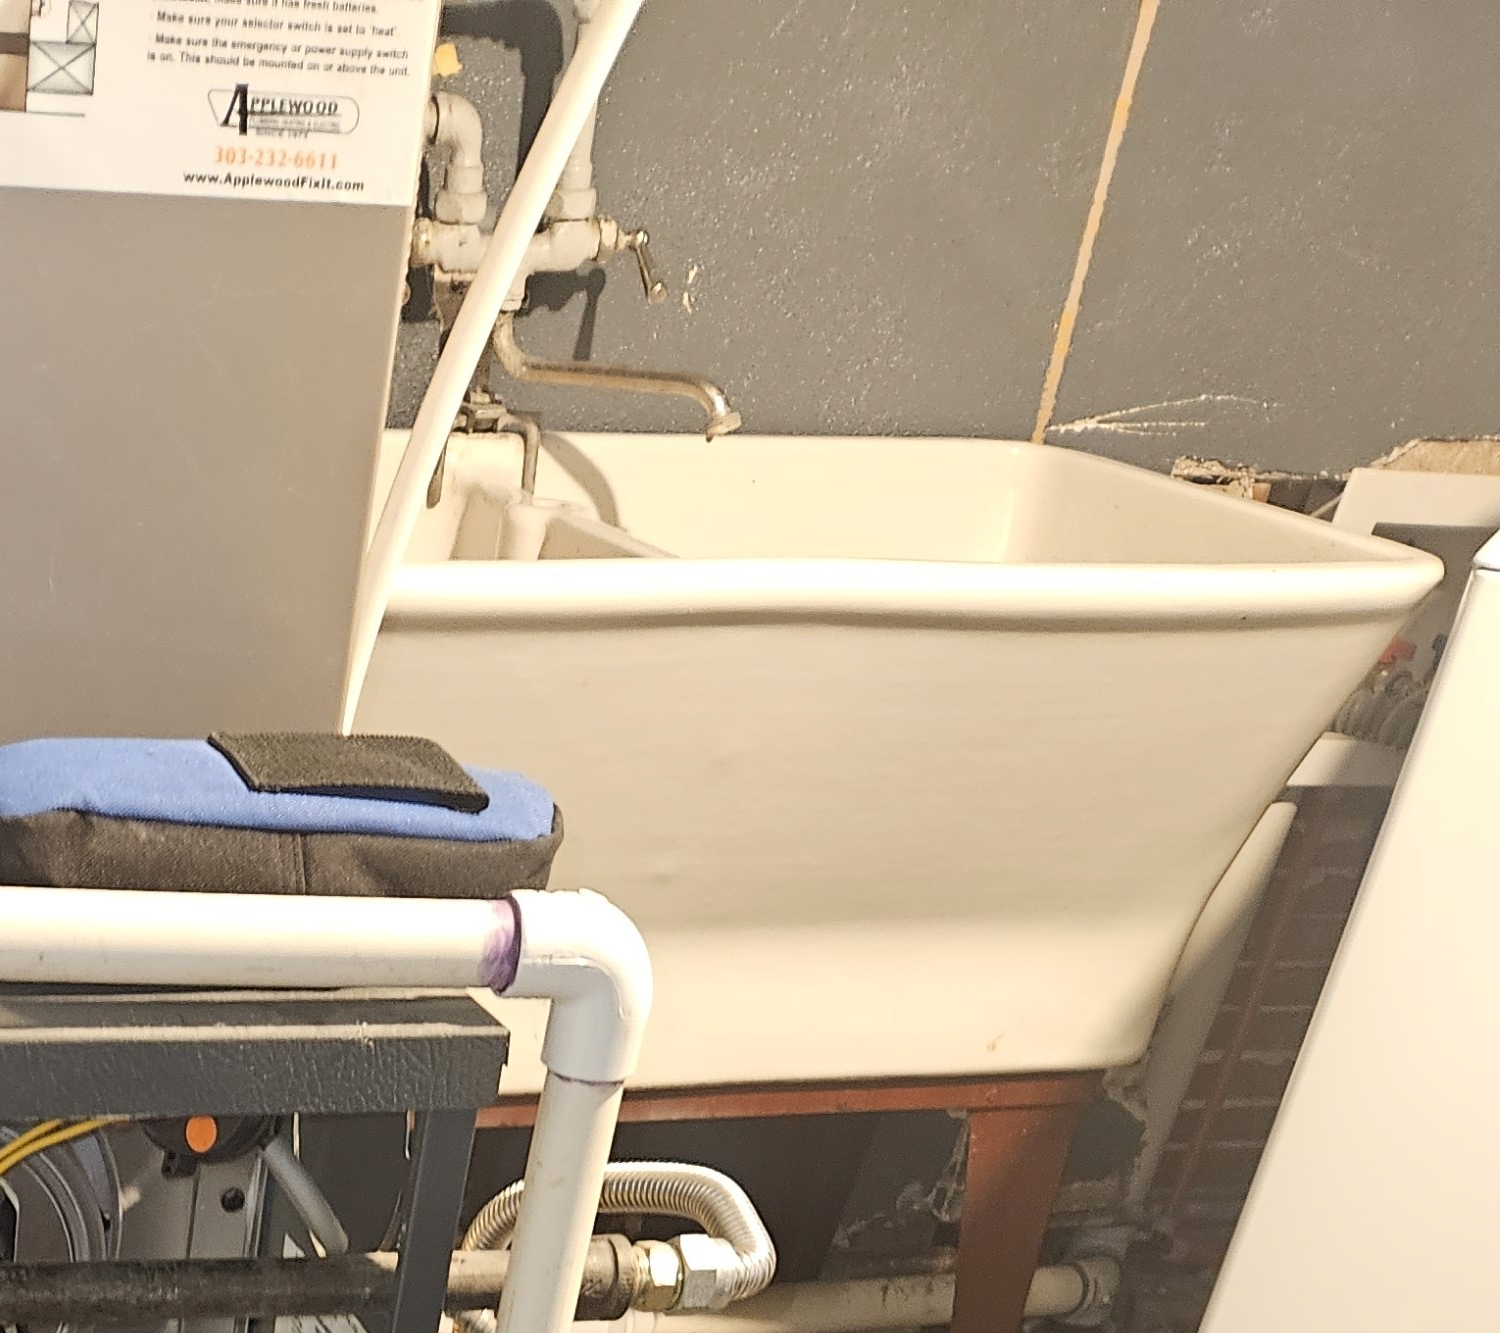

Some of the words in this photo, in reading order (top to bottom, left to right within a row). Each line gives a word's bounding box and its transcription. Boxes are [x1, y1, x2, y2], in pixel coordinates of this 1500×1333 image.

[157, 10, 185, 23] Make
[188, 15, 211, 25] sure
[214, 17, 238, 28] your
[287, 20, 321, 32] switch
[324, 22, 333, 33] is
[337, 24, 352, 34] set
[155, 33, 182, 45] Make
[186, 37, 208, 46] sure
[212, 37, 228, 48] the
[231, 40, 287, 54] emergency
[291, 44, 301, 53] or
[304, 45, 336, 55] power
[339, 46, 373, 60] supply
[376, 48, 409, 60] switch
[180, 51, 201, 63] This
[205, 54, 240, 66] should
[243, 57, 255, 67] be
[259, 58, 304, 70] mounted
[307, 62, 320, 71] on
[323, 63, 334, 72] or
[337, 62, 367, 74] above
[370, 65, 385, 75] the
[213, 146, 338, 170] 303-232-6611
